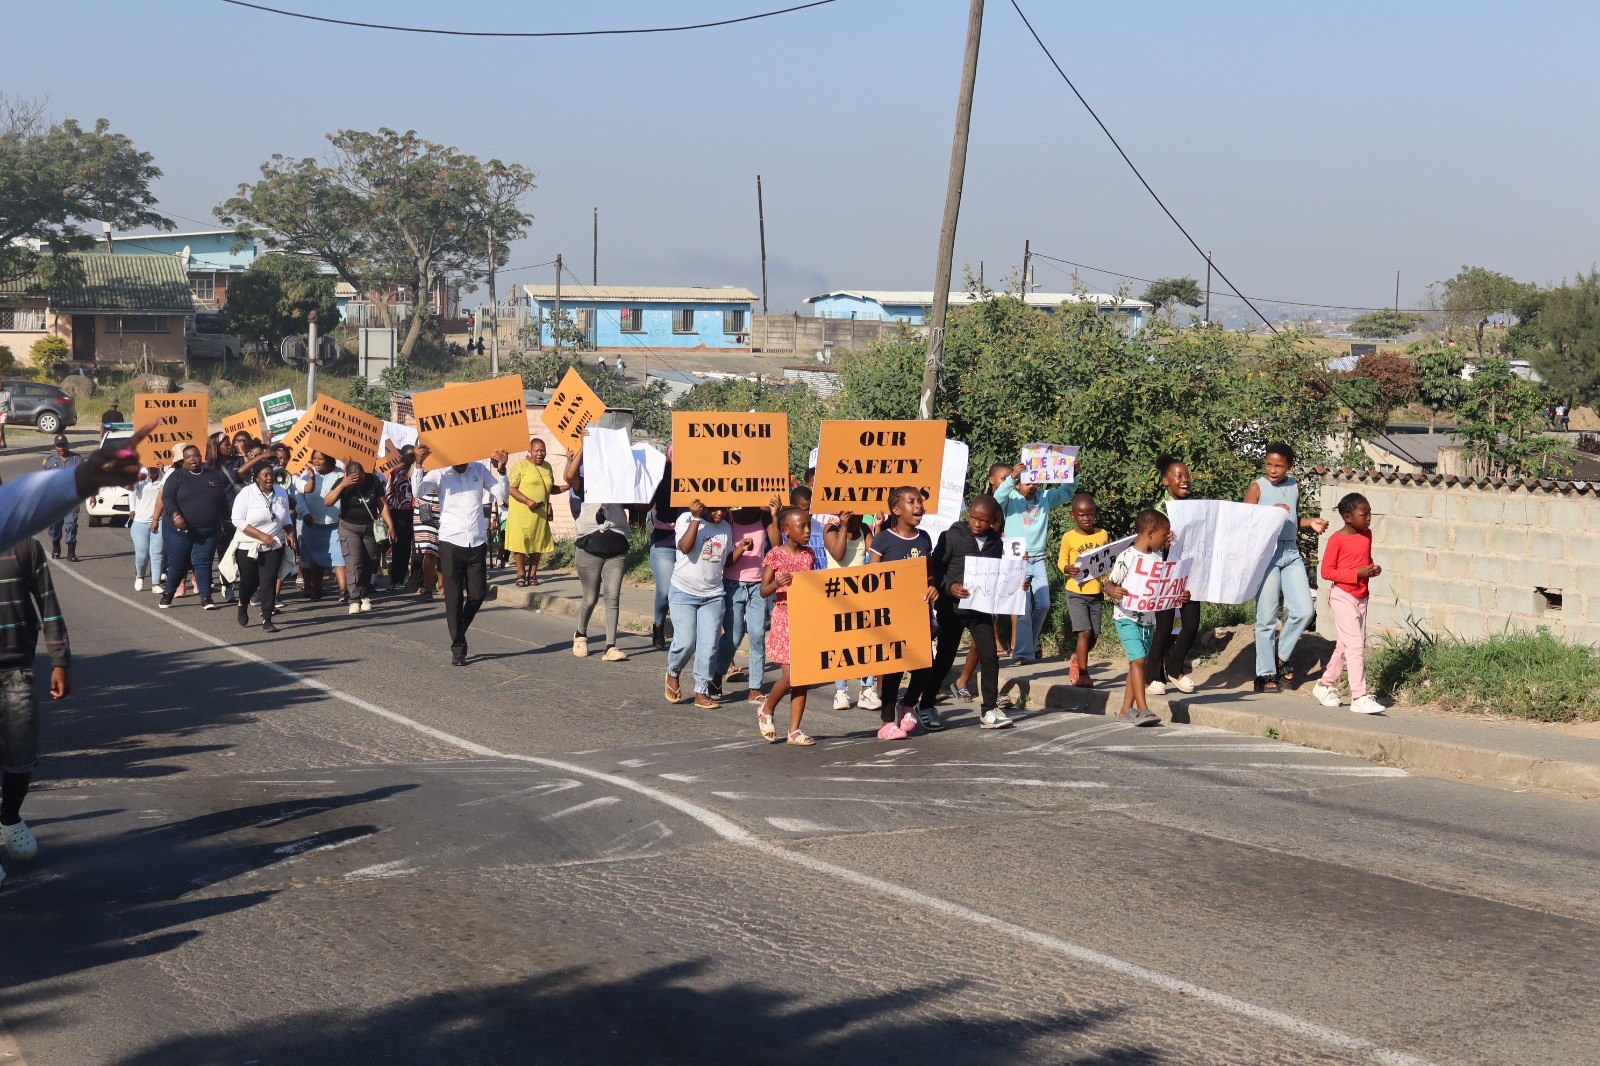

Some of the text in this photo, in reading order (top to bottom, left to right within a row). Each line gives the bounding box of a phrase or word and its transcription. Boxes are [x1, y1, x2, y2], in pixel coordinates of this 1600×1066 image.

[144, 399, 197, 409] ENOUGH
[553, 392, 566, 411] NO
[160, 415, 178, 425] NO
[323, 404, 336, 414] WE
[338, 410, 361, 426] CLAIM
[362, 421, 378, 434] OUR
[418, 398, 523, 432] KWANELE!!!!!
[557, 394, 584, 434] MEANS
[224, 417, 258, 434] WHERE AM
[316, 413, 345, 431] RIGHTS
[347, 426, 378, 446] DEMAND
[688, 423, 771, 438] ENOUGH
[147, 431, 193, 443] MEANS
[313, 424, 376, 457] ACCOUNTABILITY
[859, 431, 907, 446] OUR
[722, 450, 742, 465] IS
[1045, 445, 1065, 454] ARE
[835, 458, 923, 474] SAFETY
[1025, 457, 1047, 470] MORE
[673, 477, 786, 493] ENOUGH!!!!!
[821, 486, 931, 502] MATTS
[1076, 542, 1094, 554] HEAR
[1135, 557, 1177, 578] LET
[824, 570, 896, 598] #NOT
[833, 607, 892, 633] HER
[819, 640, 907, 670] FAULT
